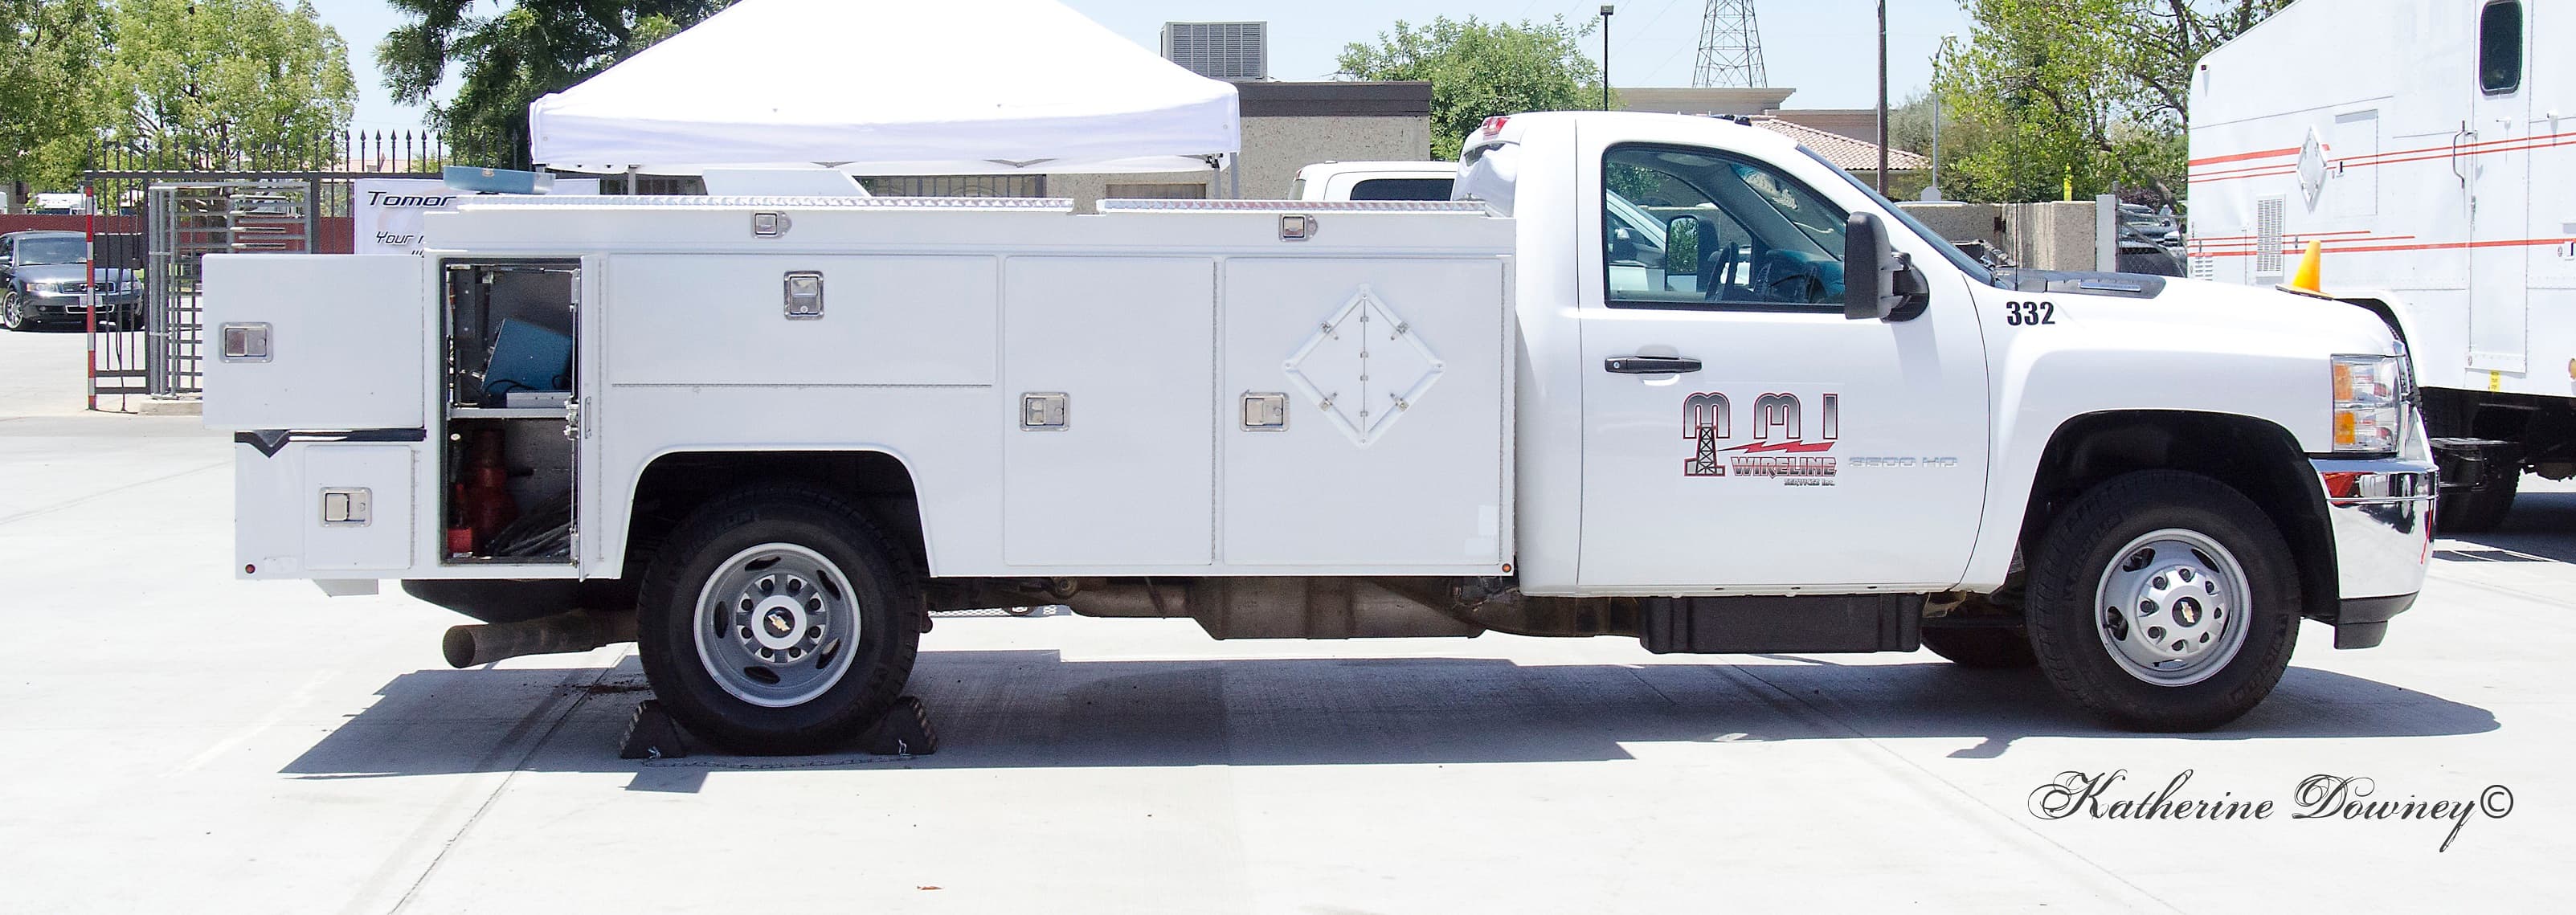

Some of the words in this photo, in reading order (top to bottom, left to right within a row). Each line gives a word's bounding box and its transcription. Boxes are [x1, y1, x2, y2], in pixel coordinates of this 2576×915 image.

[368, 191, 456, 206] Tomor
[376, 231, 414, 244] Your
[2006, 301, 2055, 325] 332
[1731, 456, 1837, 479] WIRELINE
[1849, 457, 1916, 468] 3500
[1923, 457, 1958, 468] HD
